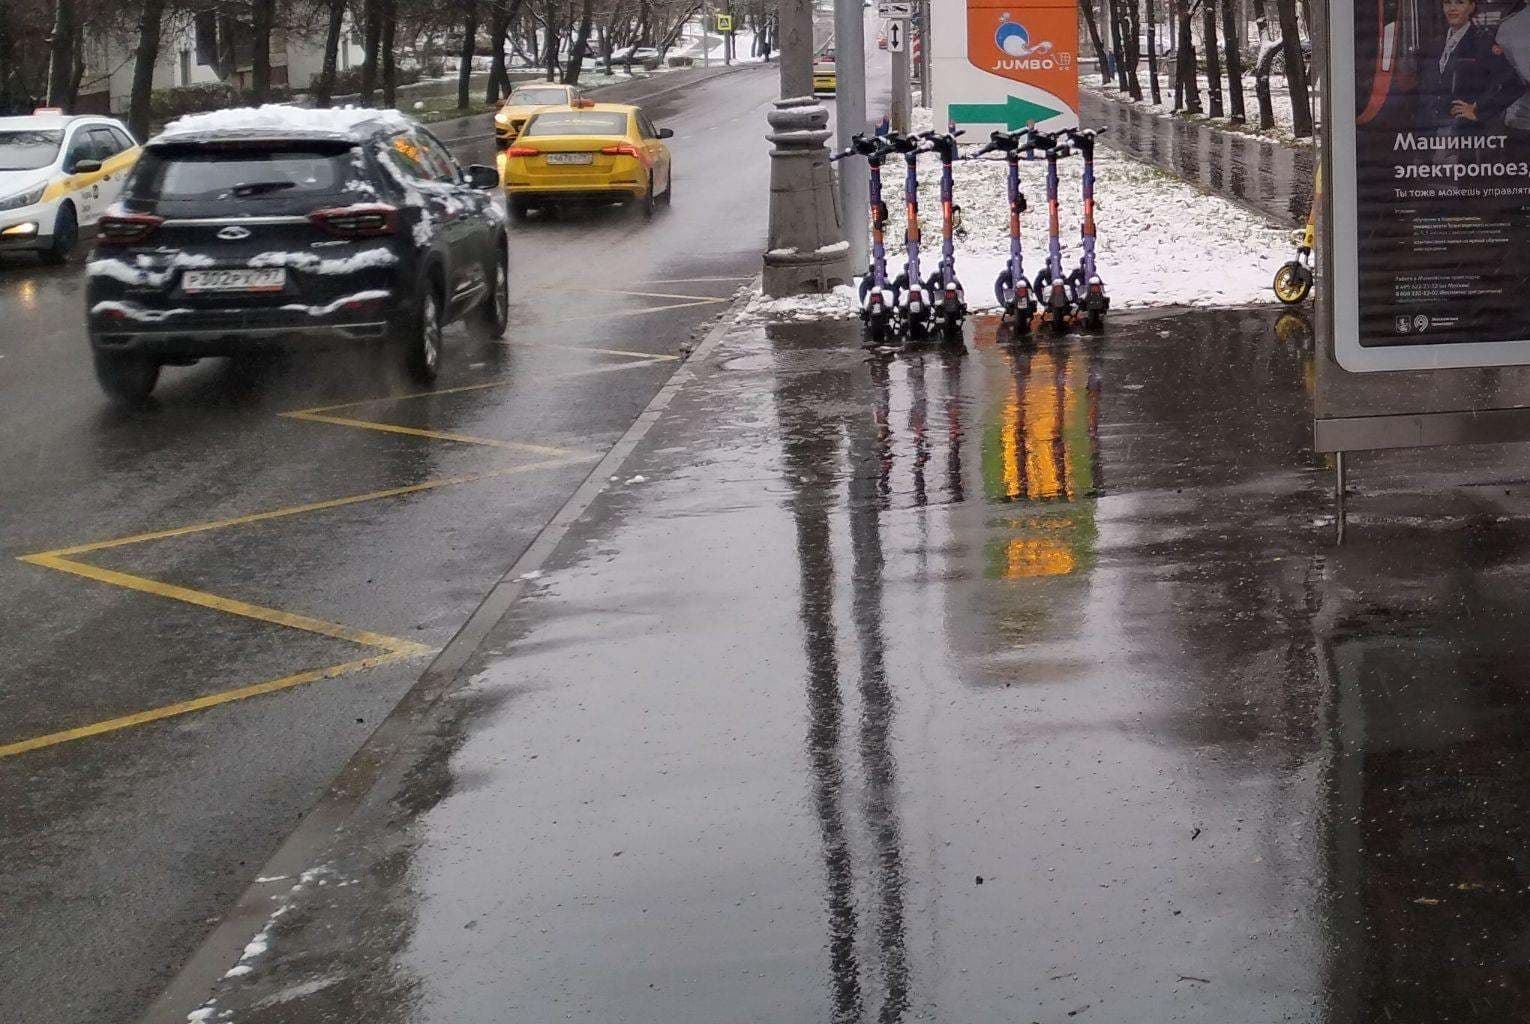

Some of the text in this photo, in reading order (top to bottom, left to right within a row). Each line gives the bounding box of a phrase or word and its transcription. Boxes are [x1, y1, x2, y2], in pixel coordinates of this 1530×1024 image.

[991, 59, 1053, 70] JUMBO
[1393, 132, 1507, 151] Машинист
[1394, 188, 1407, 198] Ты
[1409, 188, 1436, 197] тоже
[1438, 187, 1481, 197] можешь
